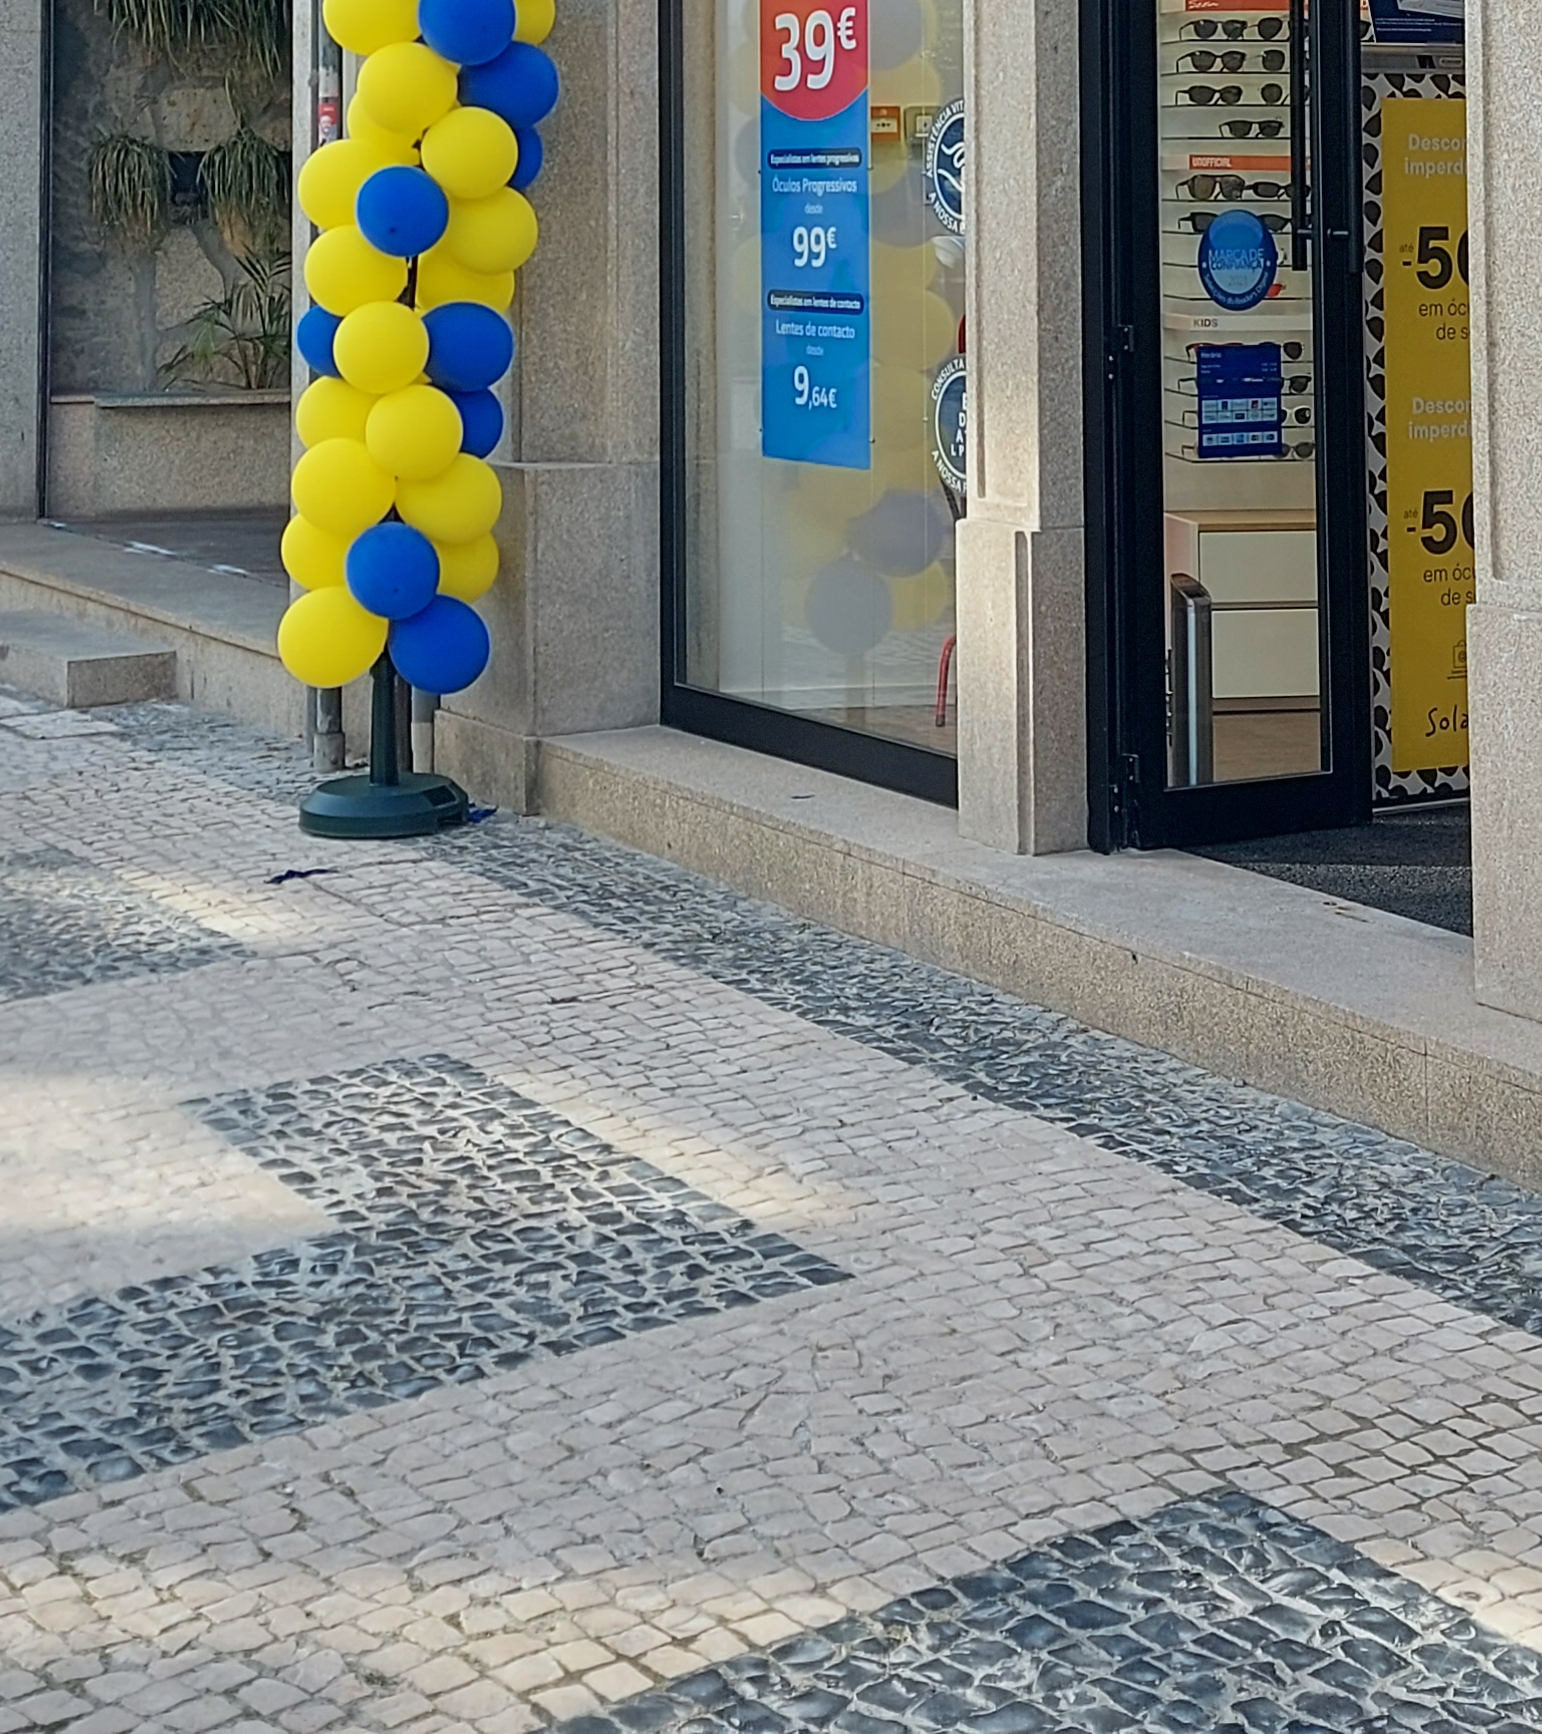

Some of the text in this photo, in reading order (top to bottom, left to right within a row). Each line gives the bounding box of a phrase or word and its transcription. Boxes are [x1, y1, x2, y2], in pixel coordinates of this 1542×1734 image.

[774, 7, 857, 91] 39€
[772, 174, 857, 197] Óculos Progressivos
[792, 226, 837, 267] 99€
[1419, 304, 1443, 317] em
[775, 319, 856, 339] Lentes de contacto
[1194, 318, 1218, 327] KIDS
[1436, 324, 1456, 340] de
[794, 365, 837, 410] 9,64€
[1423, 568, 1447, 583] em
[1440, 589, 1461, 606] de
[1425, 704, 1469, 738] Sola
